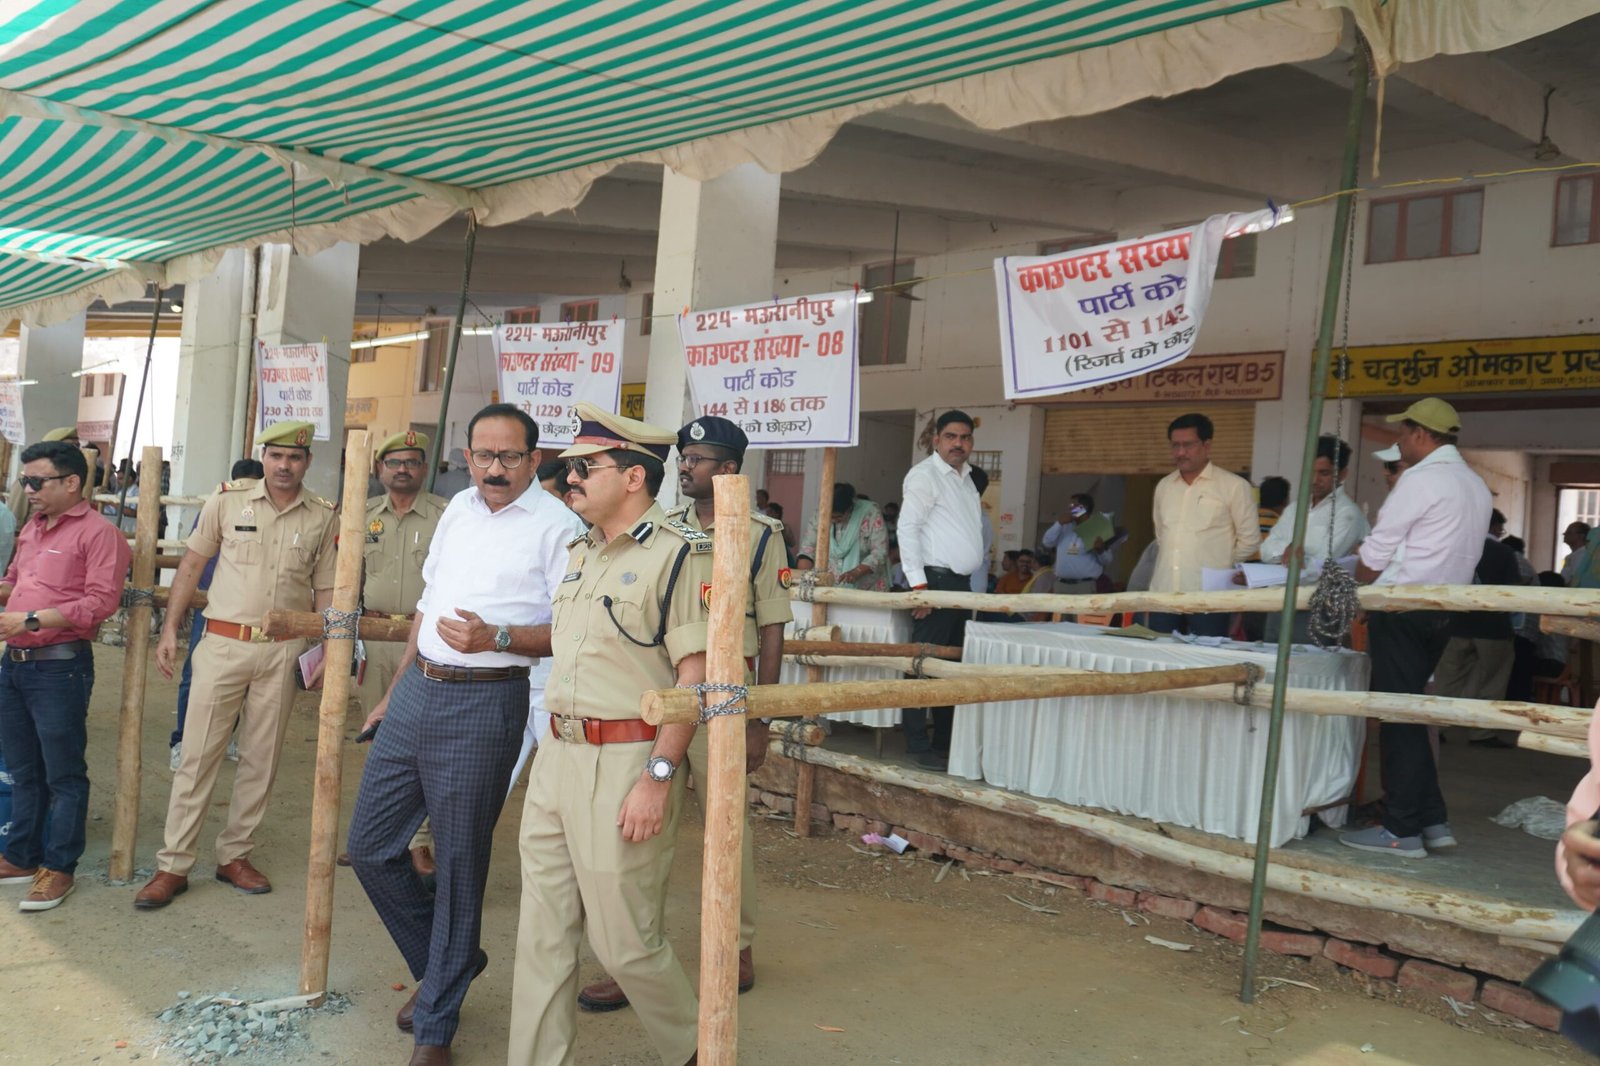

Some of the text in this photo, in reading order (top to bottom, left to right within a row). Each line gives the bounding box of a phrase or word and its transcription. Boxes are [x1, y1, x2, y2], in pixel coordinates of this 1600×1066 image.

[1016, 235, 1193, 294] काउण्टर संख्य
[743, 297, 835, 326] मऊरानीपुर
[1077, 282, 1136, 316] पार्टी
[542, 322, 608, 346] मऊरानीपुर
[1043, 330, 1092, 354] 1101
[1101, 319, 1131, 343] से
[686, 339, 750, 368] काउण्टर
[817, 330, 845, 357] 08
[1065, 325, 1195, 377] (रिजर्व को छोड़
[591, 352, 615, 374] 09
[1363, 349, 1443, 386] चतुर्भुज
[1448, 347, 1556, 379] ओमकार
[517, 376, 574, 397] पार्टी कोड
[723, 367, 797, 392] पार्टी कोड
[535, 405, 562, 417] 1229
[734, 397, 749, 416] से
[790, 396, 827, 412] तक
[543, 421, 572, 437] छोड़क
[745, 420, 761, 433] को
